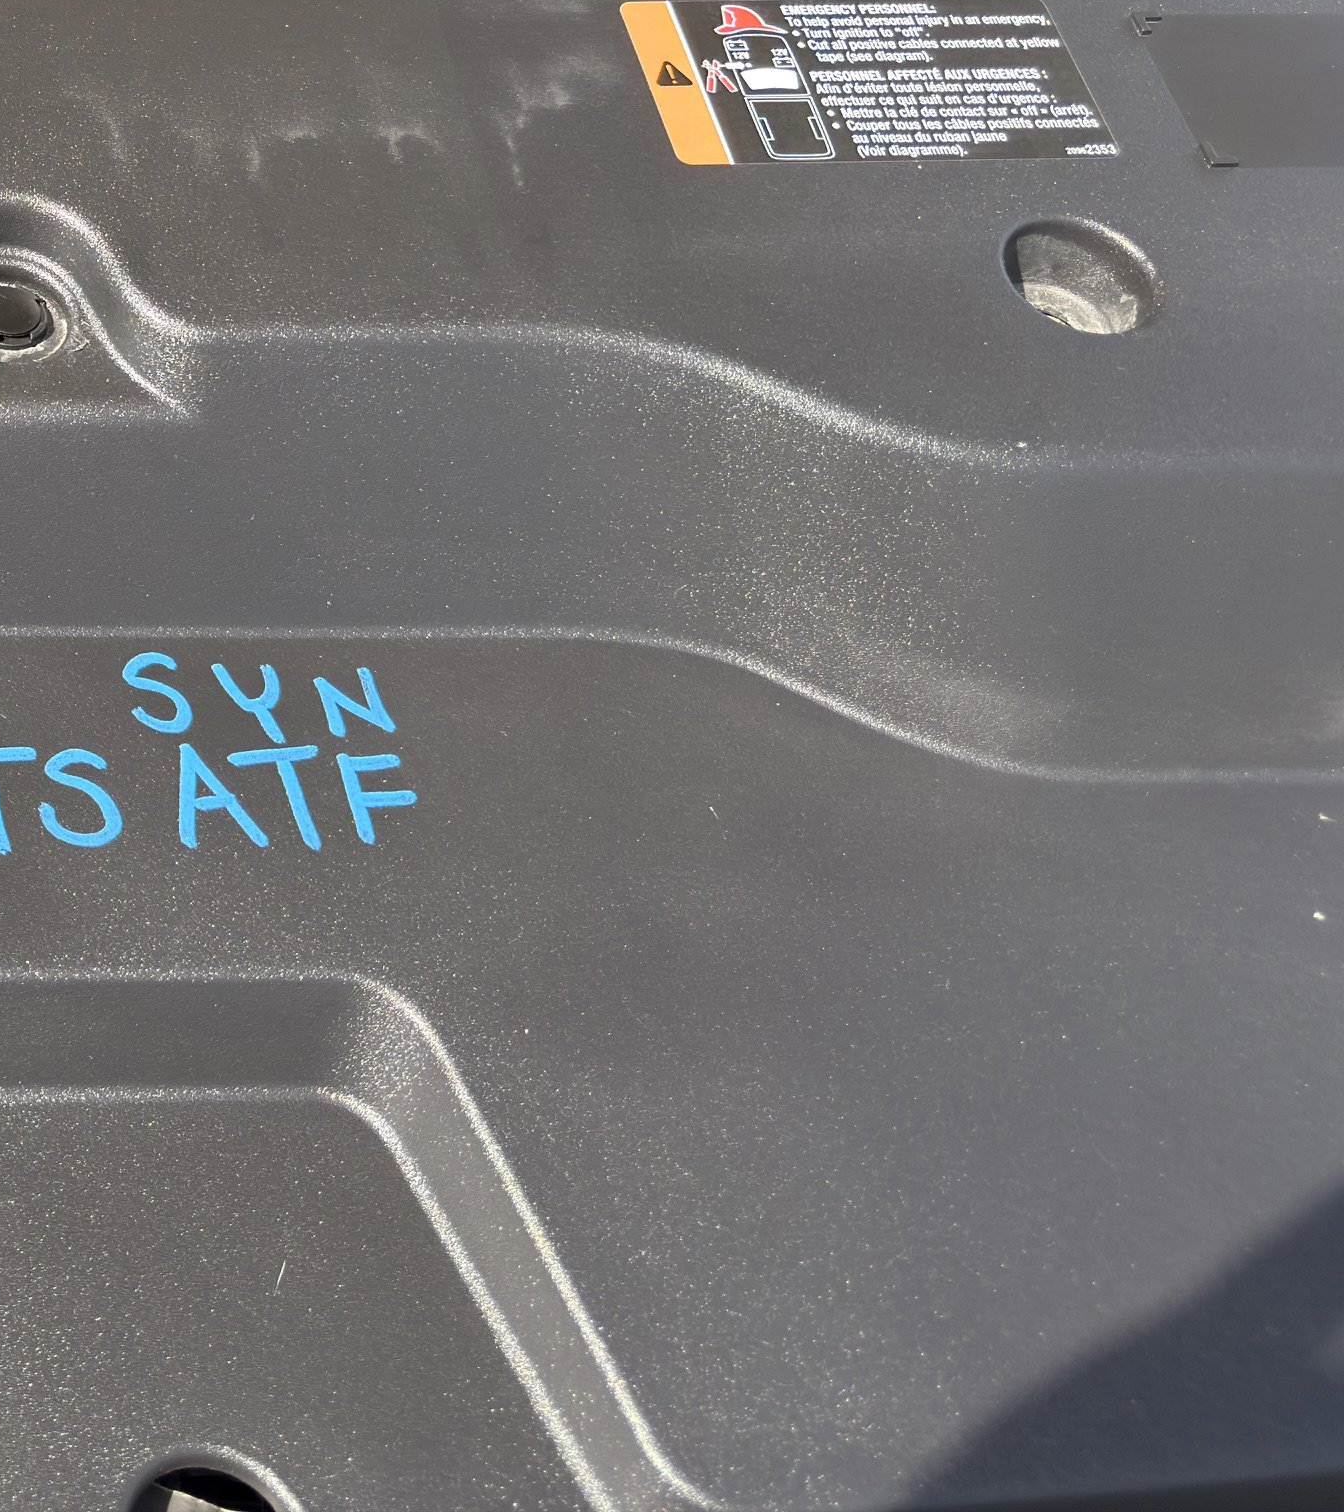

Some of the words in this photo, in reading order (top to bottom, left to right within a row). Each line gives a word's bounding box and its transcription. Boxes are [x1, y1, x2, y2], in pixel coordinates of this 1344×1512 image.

[780, 5, 856, 15] EMERGENCY
[858, 4, 937, 14] PERSONNEL:
[809, 71, 886, 82] PERSONNEL
[887, 68, 943, 80] AFFECTÉ
[944, 70, 972, 79] AUX
[972, 69, 1041, 79] URGENCES
[120, 651, 396, 744] SYN
[178, 743, 419, 853] ATF
